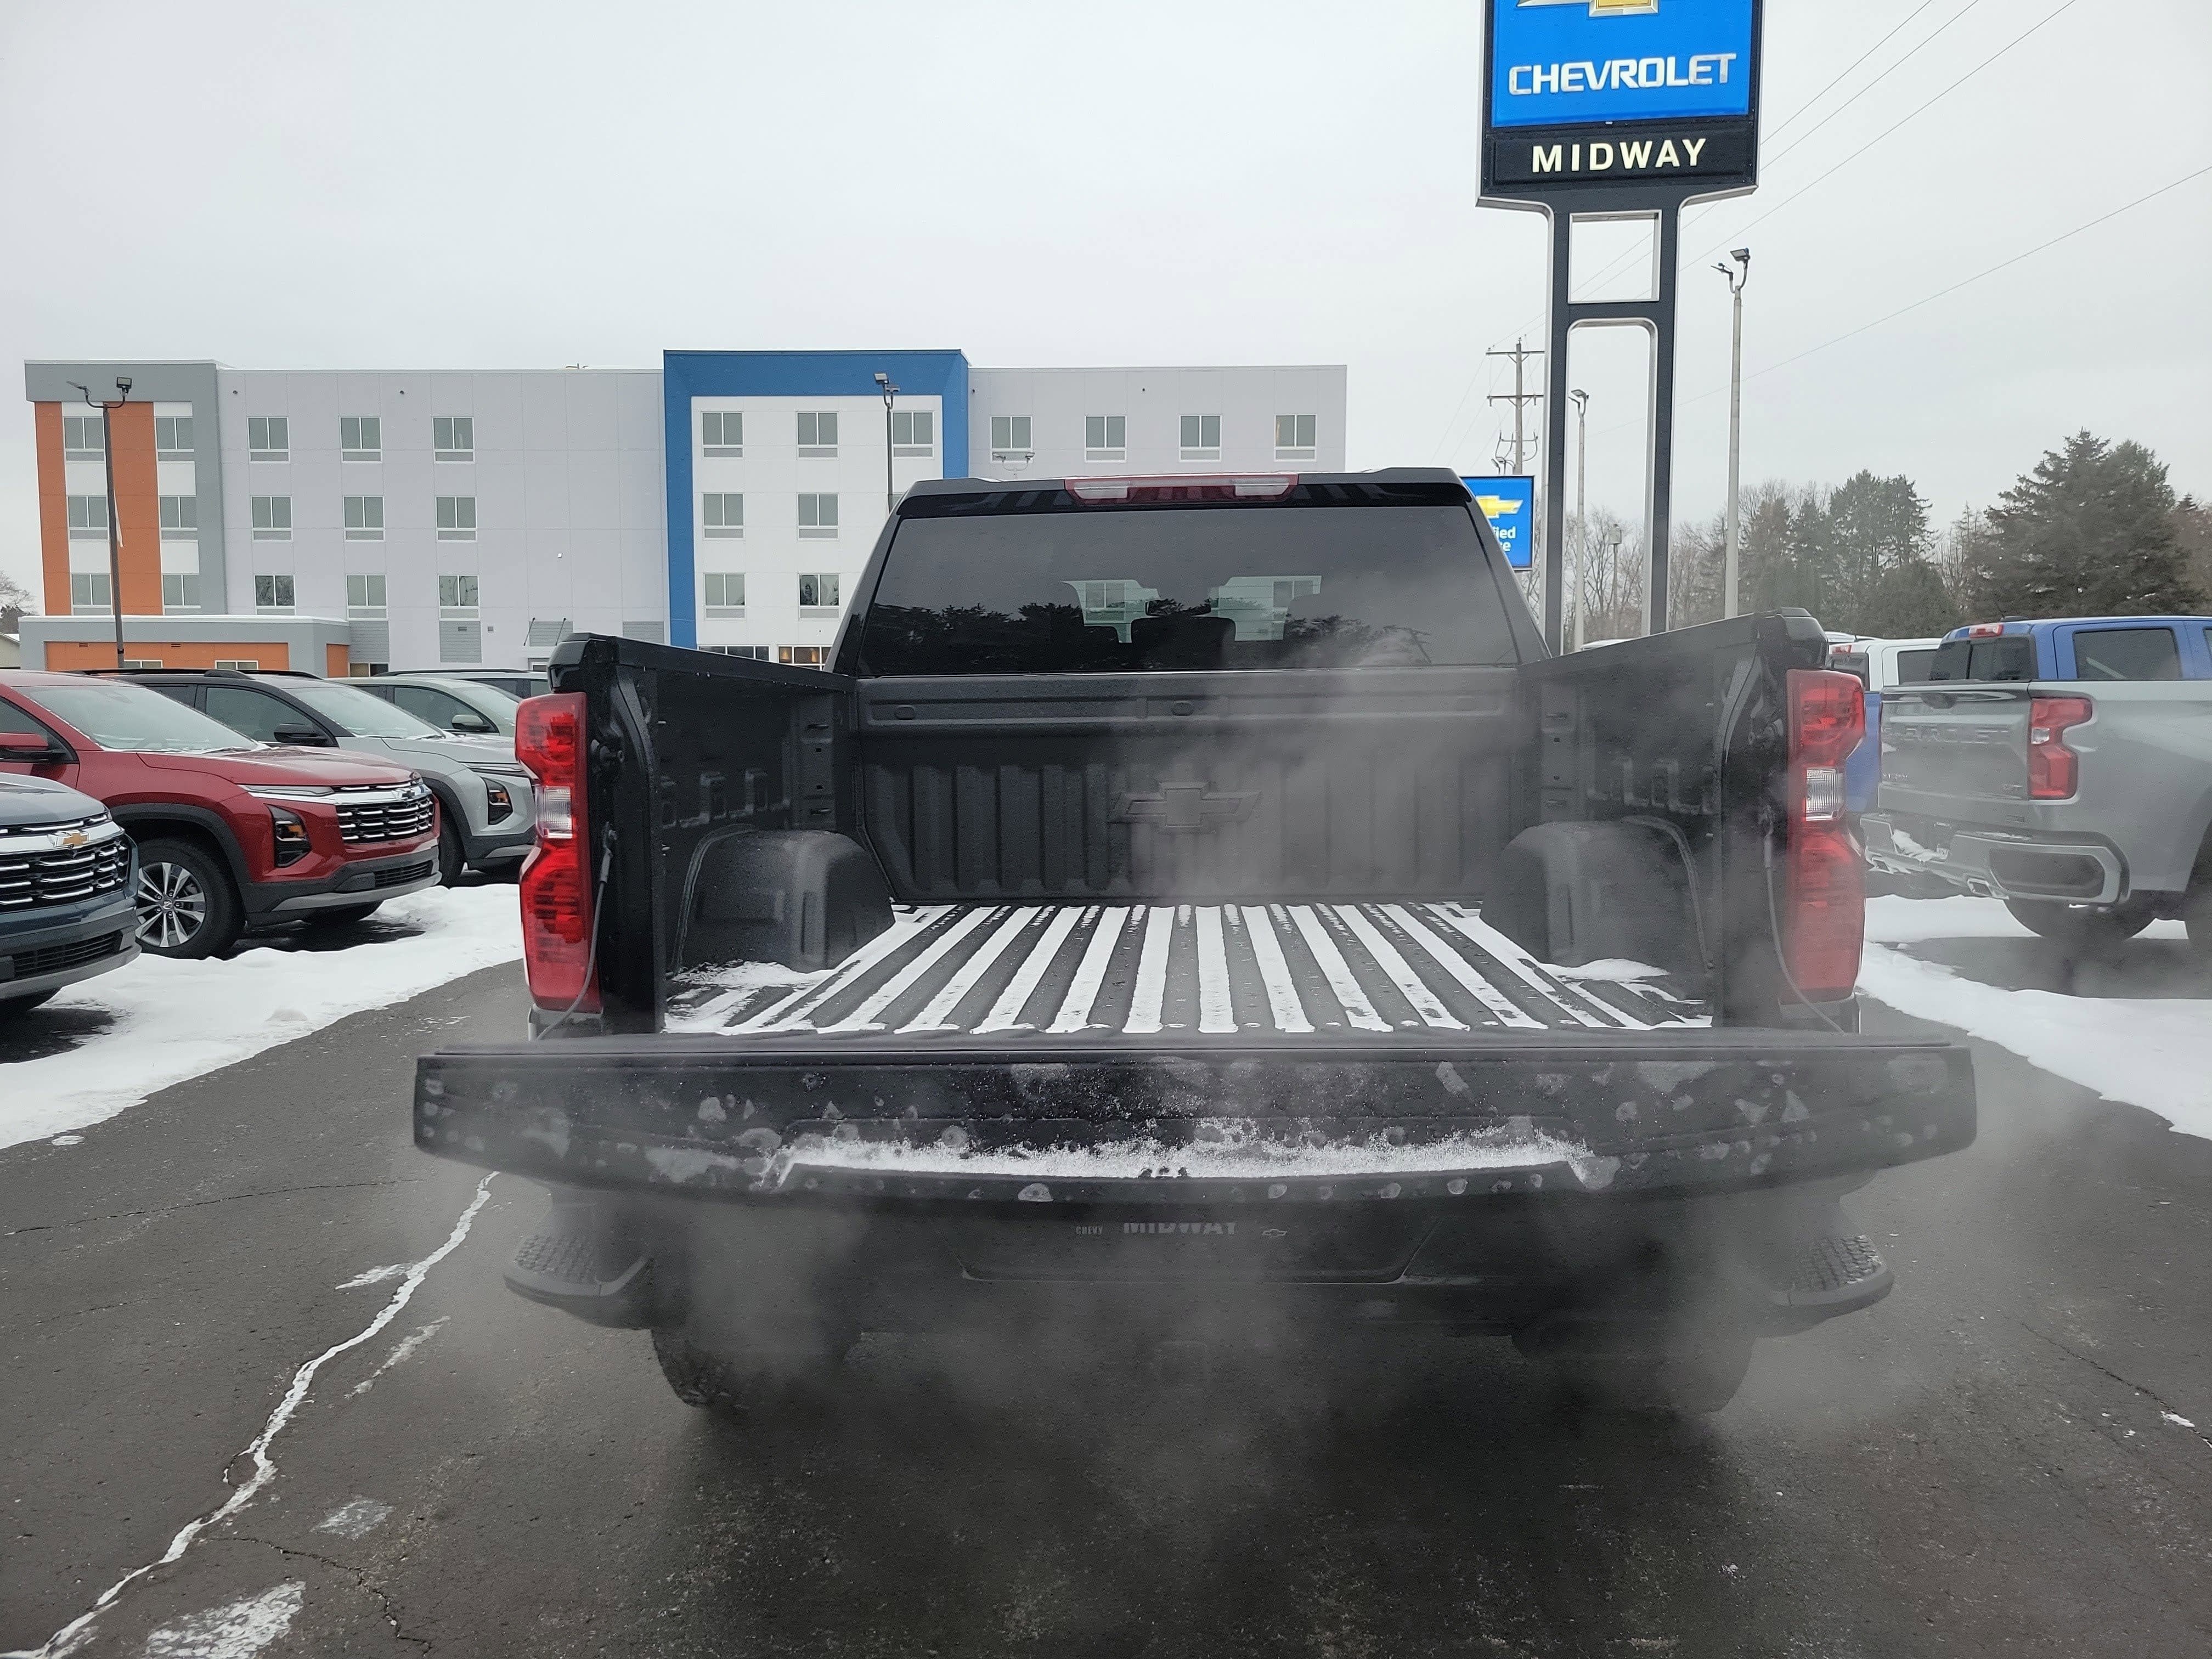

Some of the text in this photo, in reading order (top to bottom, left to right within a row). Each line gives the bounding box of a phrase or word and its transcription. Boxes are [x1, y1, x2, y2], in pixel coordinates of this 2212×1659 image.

[1508, 53, 1736, 95] CHEVROLET
[1532, 138, 1706, 173] MIDWAY
[1076, 1222, 1236, 1235] CHEVY MIDWAY
